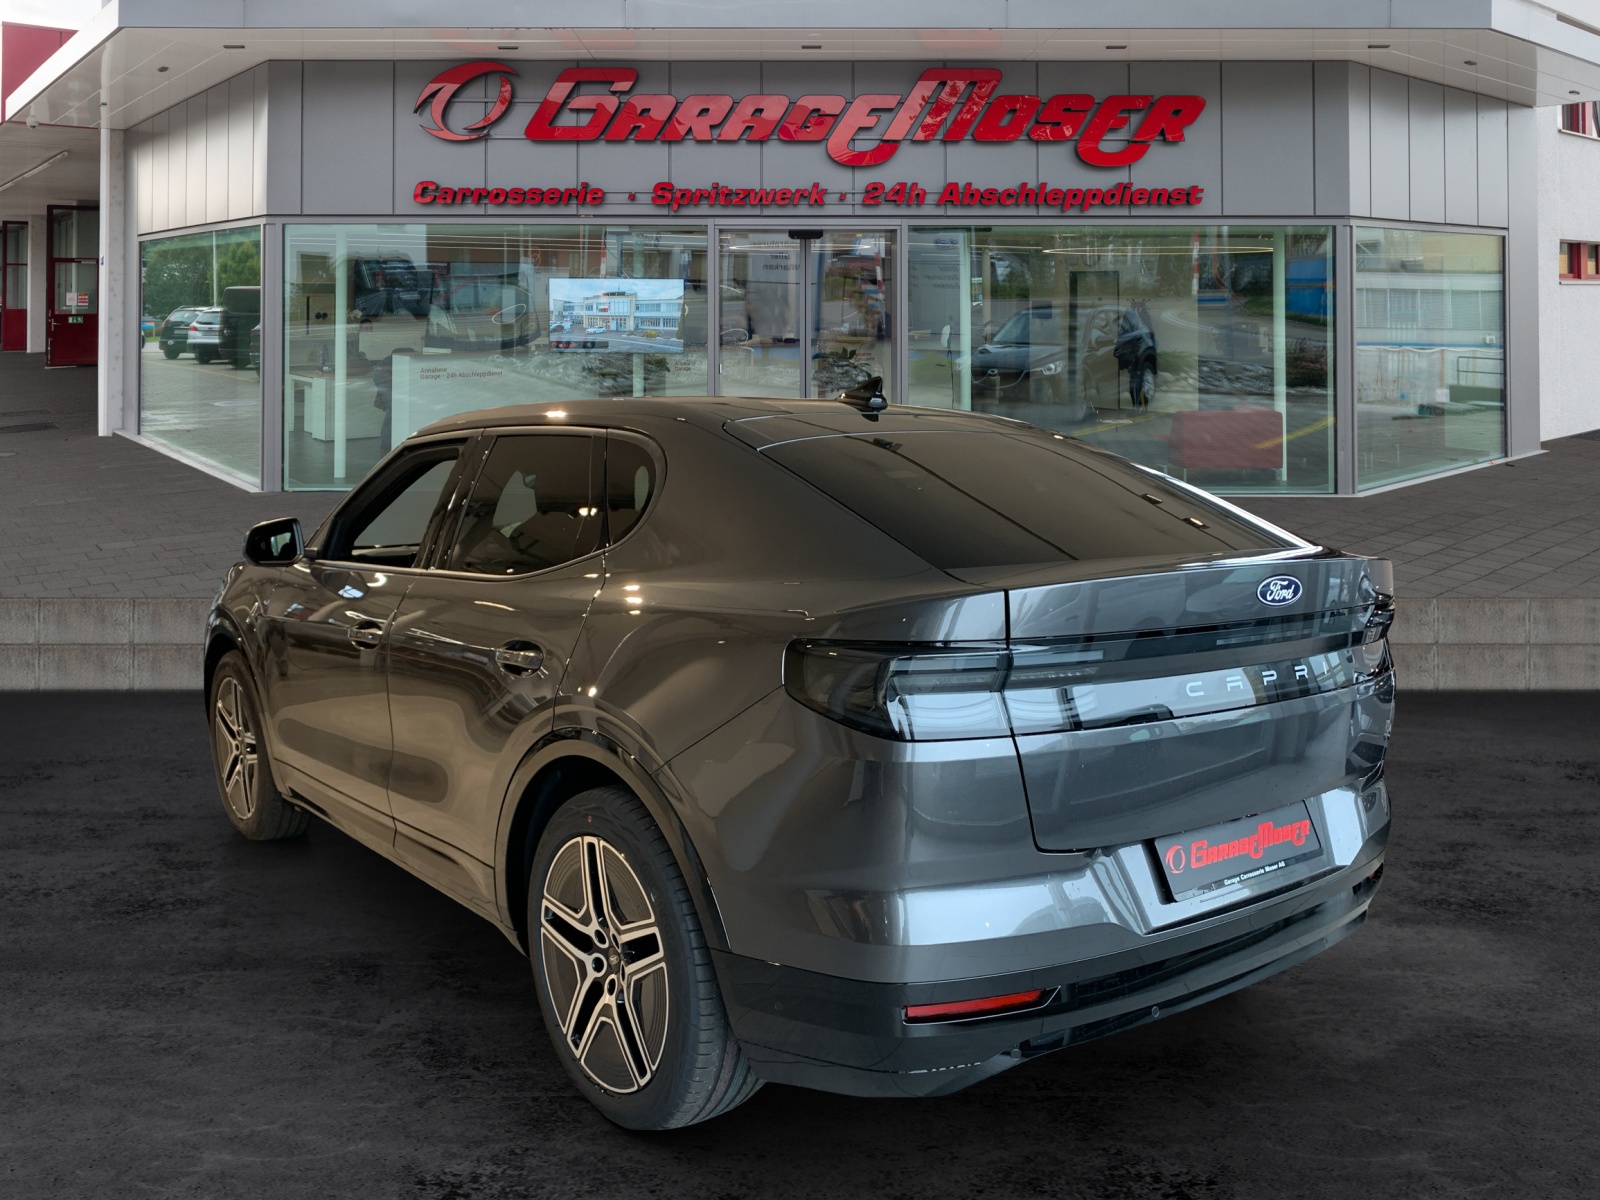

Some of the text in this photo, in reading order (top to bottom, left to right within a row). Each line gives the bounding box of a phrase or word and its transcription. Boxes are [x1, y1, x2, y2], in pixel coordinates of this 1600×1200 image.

[413, 181, 605, 205] Carrosserie
[651, 181, 827, 211] Spritzwerk
[862, 181, 927, 206] 24h
[937, 182, 1205, 211] Abschleppdienst
[1266, 580, 1295, 601] Ford
[1185, 661, 1328, 697] CAPRI
[1223, 876, 1240, 886] Garage
